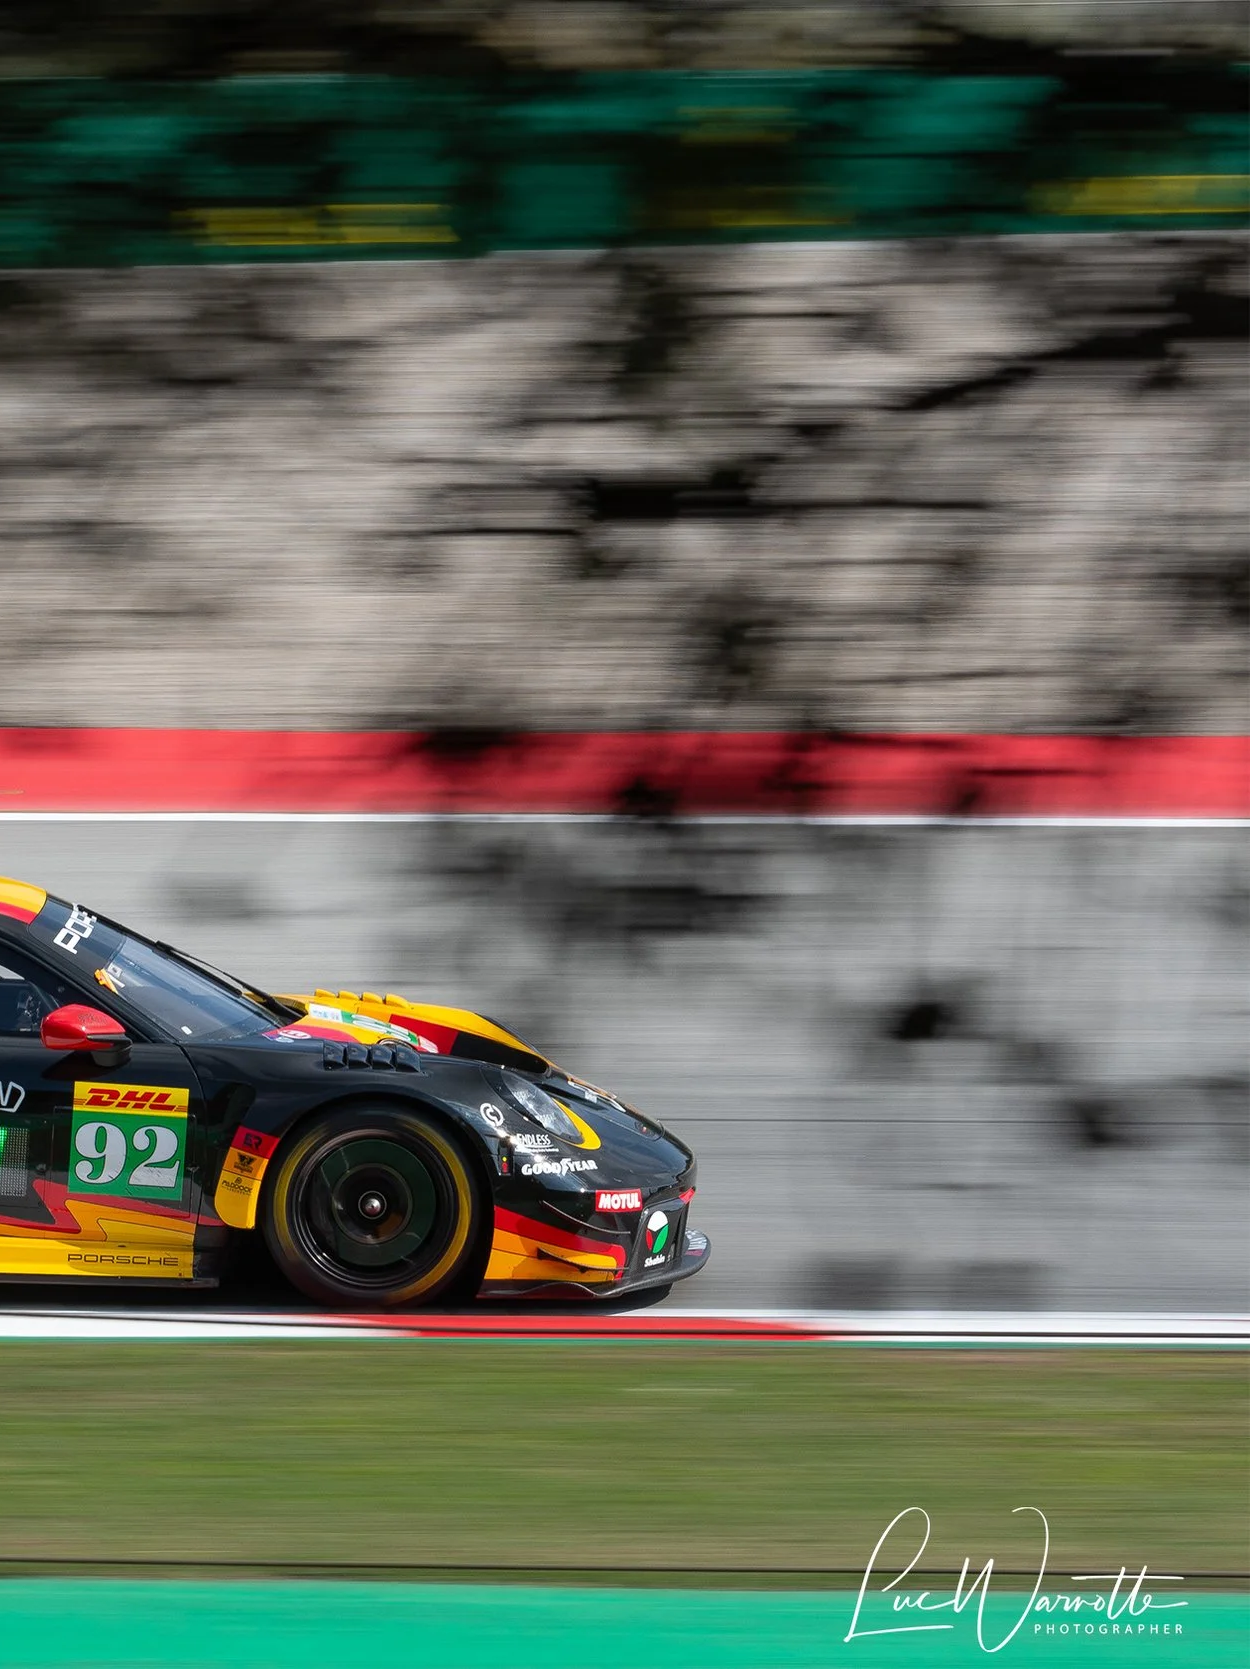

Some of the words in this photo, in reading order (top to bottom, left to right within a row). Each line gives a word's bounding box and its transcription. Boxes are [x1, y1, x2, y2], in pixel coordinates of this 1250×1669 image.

[85, 1088, 176, 1111] DHL
[516, 1133, 551, 1145] ENDLESS
[75, 1122, 180, 1188] 92
[598, 1193, 641, 1209] MOTUL
[67, 1253, 179, 1266] PORSCHE
